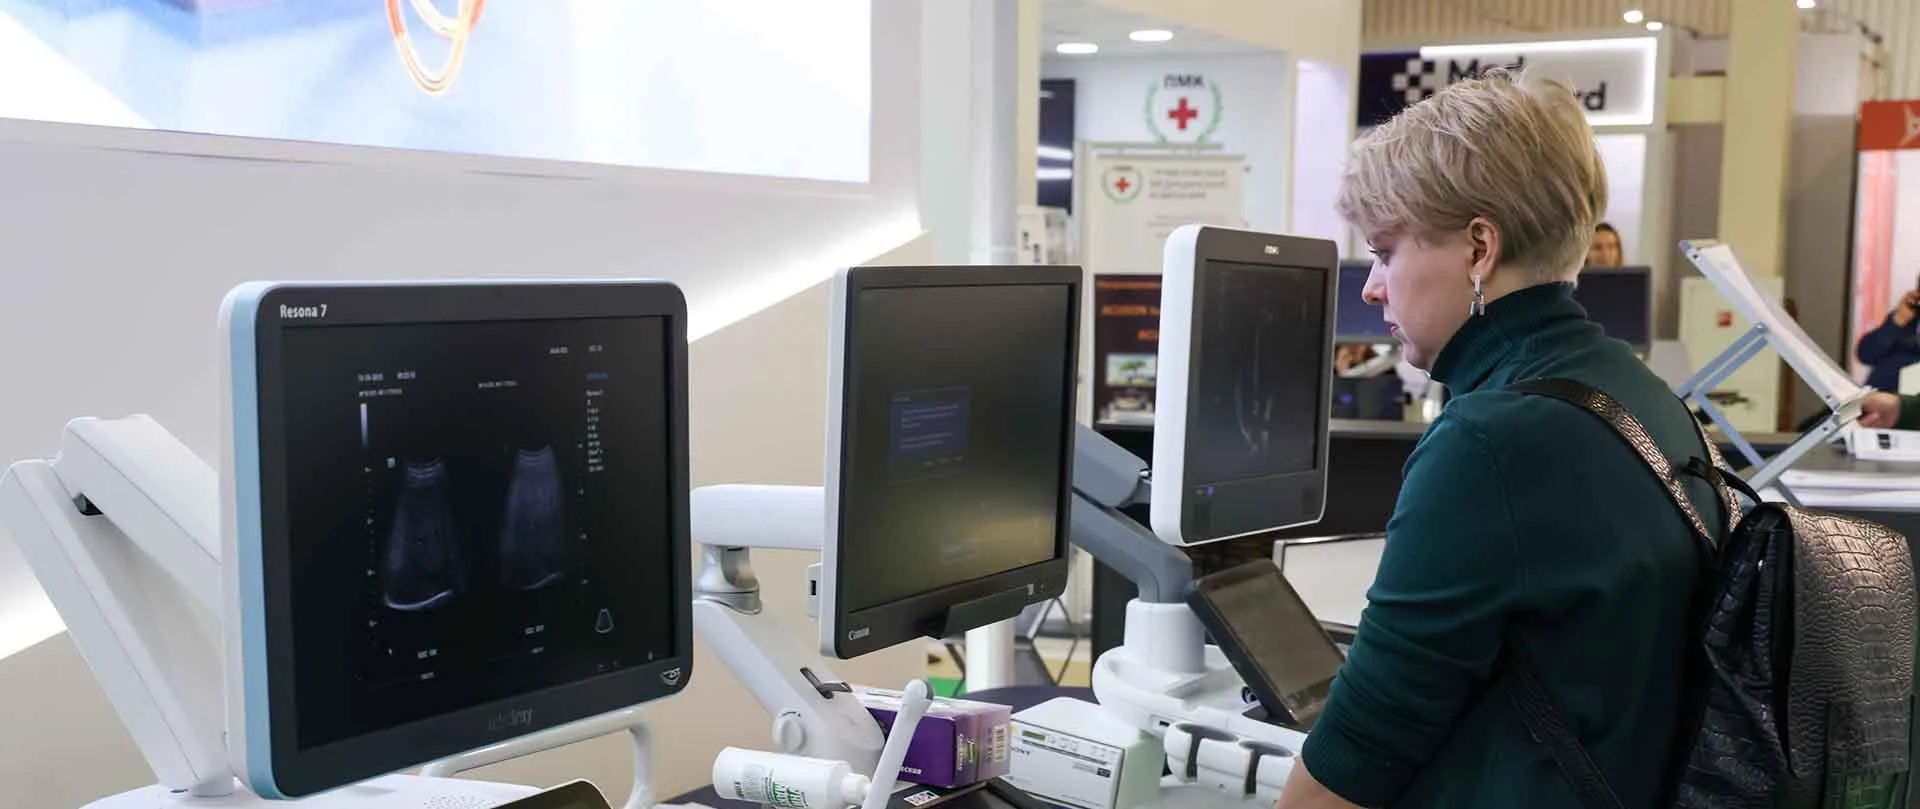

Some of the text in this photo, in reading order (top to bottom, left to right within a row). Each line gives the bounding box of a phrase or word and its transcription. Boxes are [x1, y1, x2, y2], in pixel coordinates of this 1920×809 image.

[1163, 74, 1205, 88] ПМК
[280, 303, 328, 319] Resona 7
